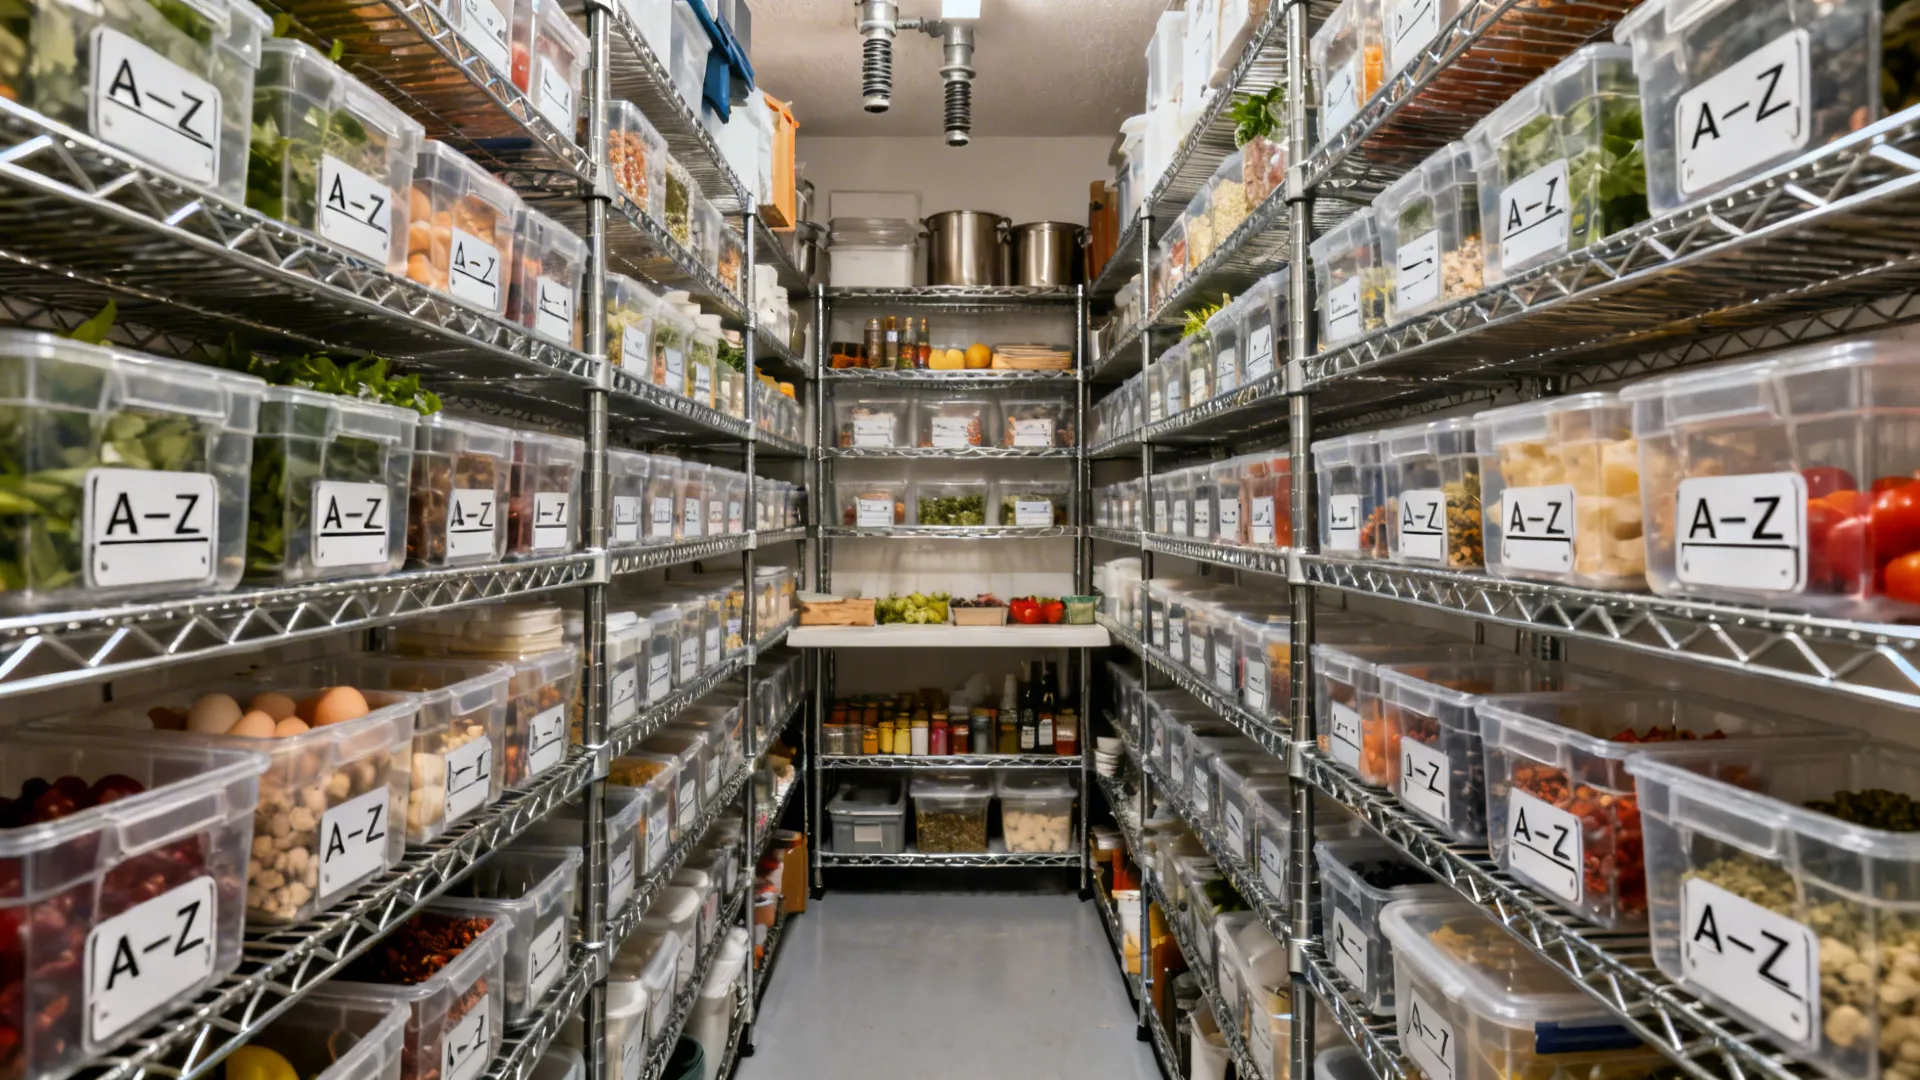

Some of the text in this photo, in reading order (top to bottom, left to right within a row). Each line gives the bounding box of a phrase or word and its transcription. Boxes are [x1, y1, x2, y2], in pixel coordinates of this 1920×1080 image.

[106, 493, 201, 536] A-Z
[323, 498, 383, 529] A-Z
[1690, 496, 1784, 540] A-Z
[324, 804, 385, 864] A-Z
[106, 902, 204, 991] A-Z
[1693, 903, 1790, 989] A-Z
